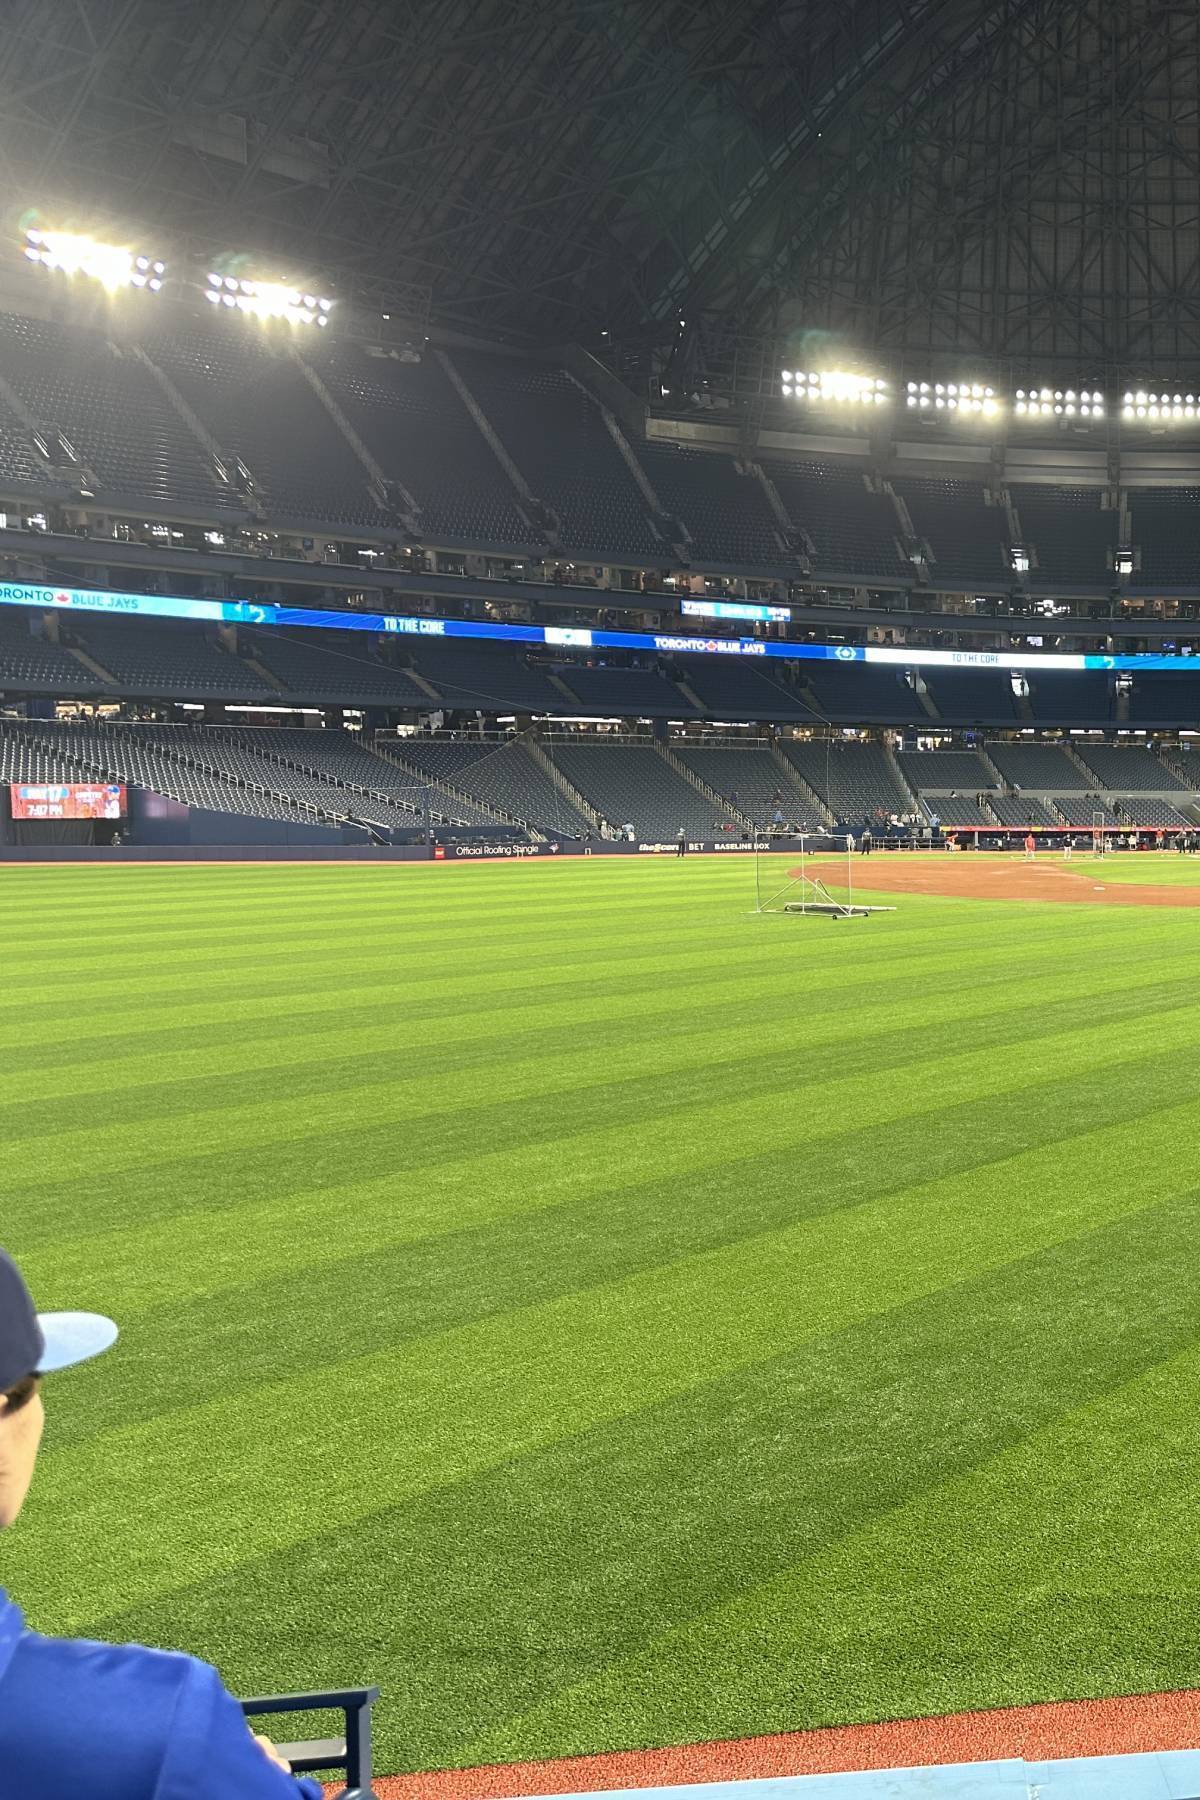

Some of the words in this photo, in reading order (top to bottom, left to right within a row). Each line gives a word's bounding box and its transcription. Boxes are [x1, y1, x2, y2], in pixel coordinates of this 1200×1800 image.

[72, 594, 105, 606] BLUE
[107, 598, 139, 609] JAYS
[654, 638, 705, 650] TORONTO
[717, 642, 740, 652] BLUE
[743, 644, 765, 654] JAYS
[456, 847, 482, 856] Official
[484, 846, 512, 856] Roofing
